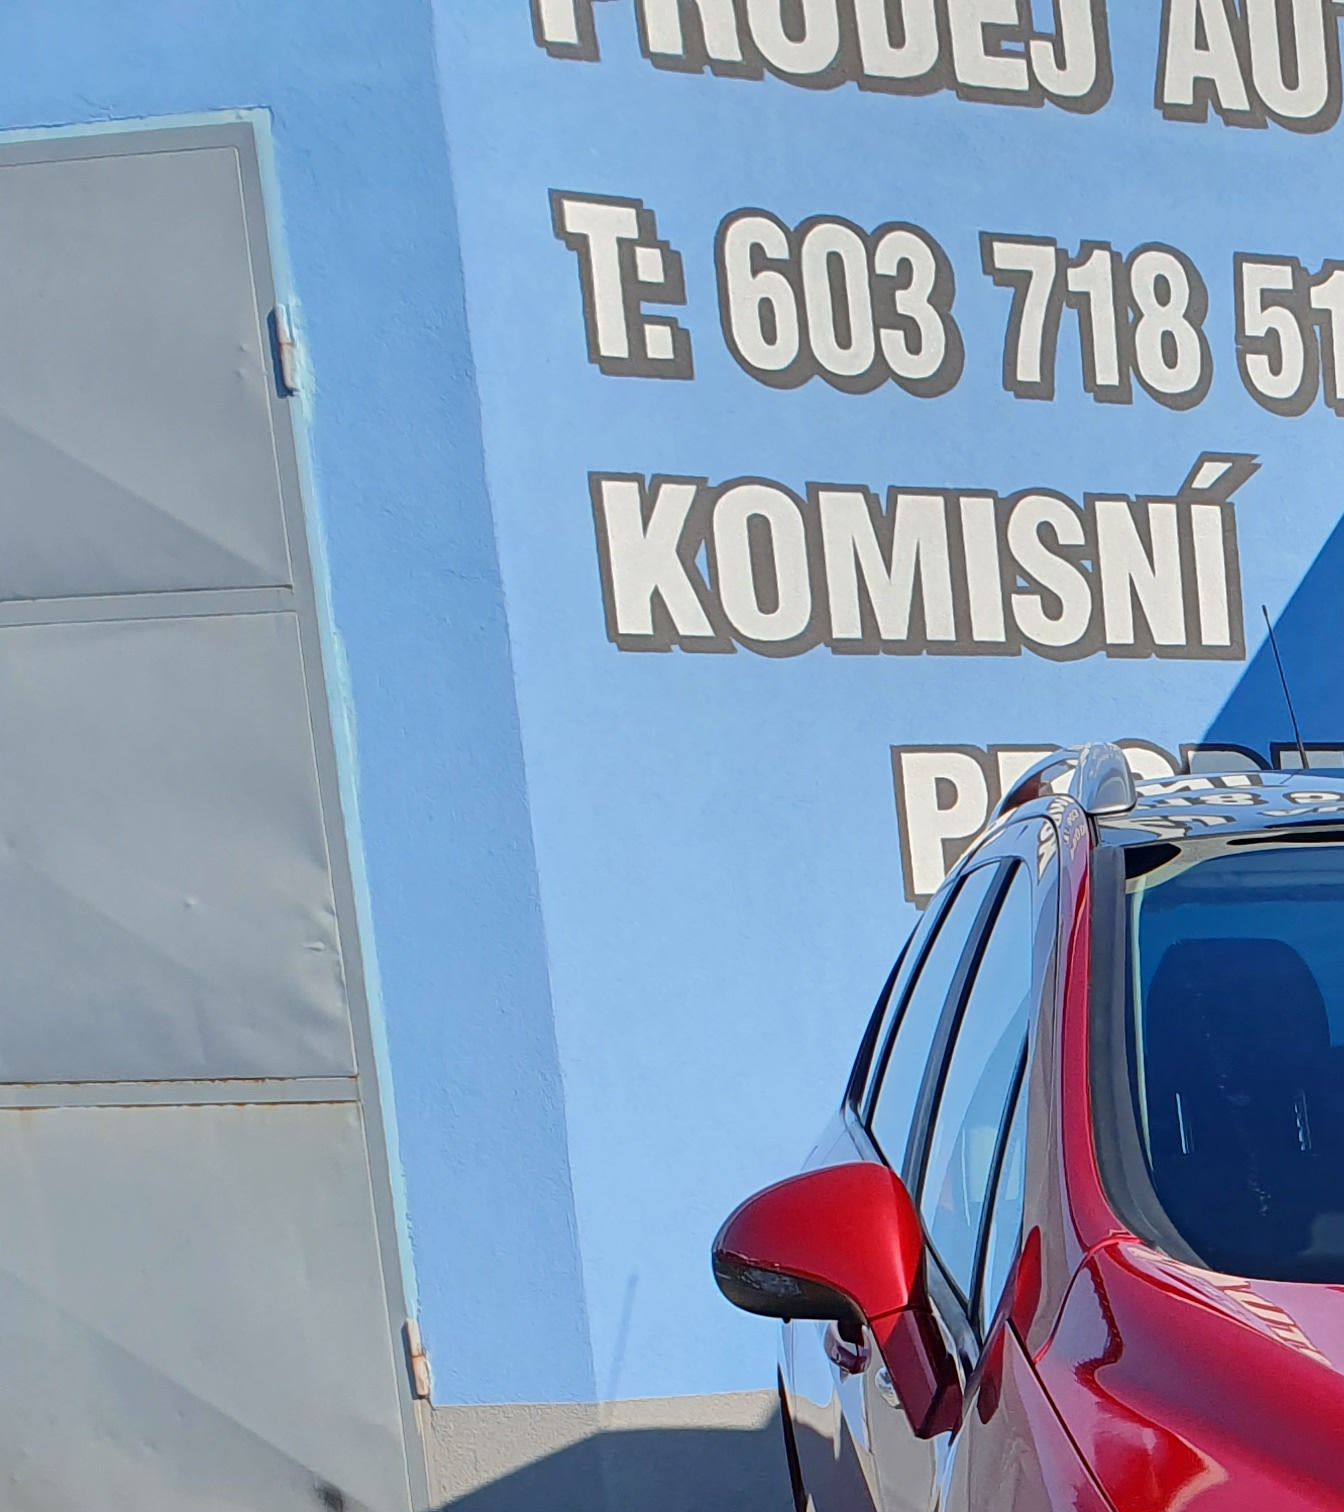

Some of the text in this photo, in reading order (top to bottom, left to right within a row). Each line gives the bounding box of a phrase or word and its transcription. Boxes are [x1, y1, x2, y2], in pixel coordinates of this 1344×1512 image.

[530, 0, 1113, 115] DEJ
[548, 190, 694, 380] T:
[714, 207, 966, 398] 603
[980, 231, 1213, 411] 718
[588, 452, 1260, 662] KOMISNÍ
